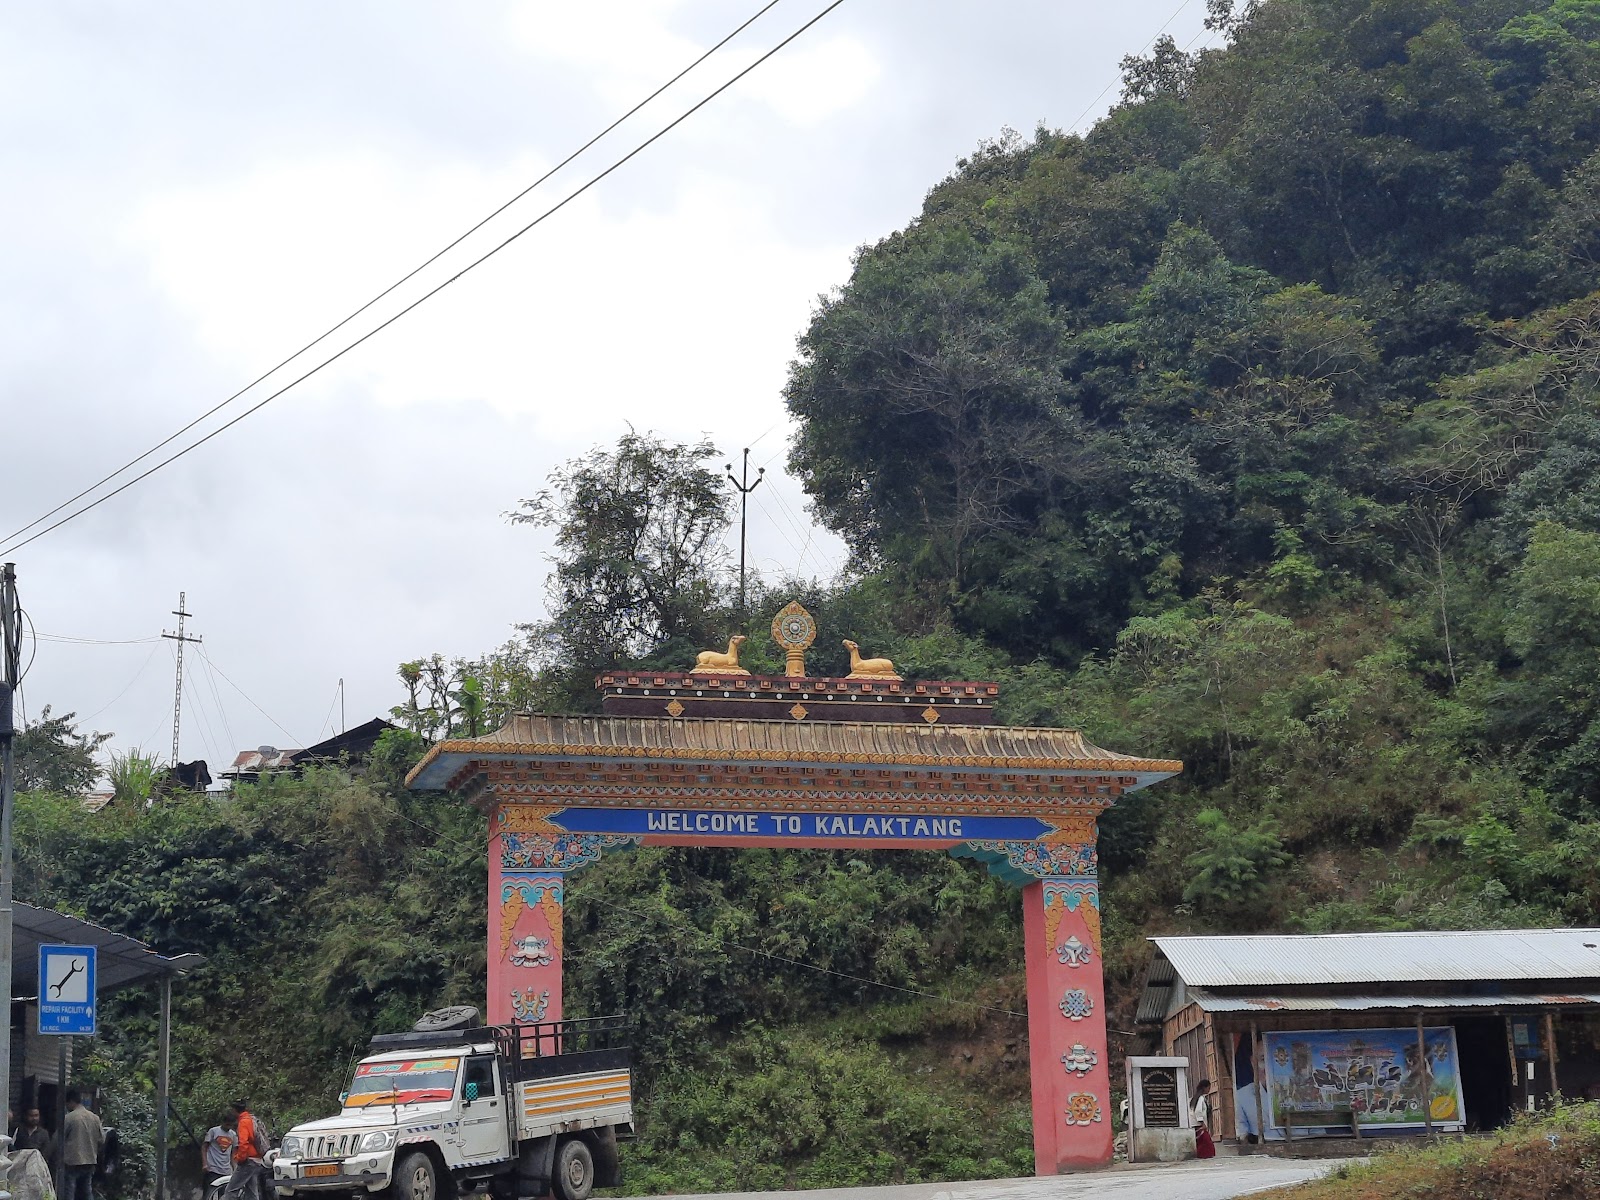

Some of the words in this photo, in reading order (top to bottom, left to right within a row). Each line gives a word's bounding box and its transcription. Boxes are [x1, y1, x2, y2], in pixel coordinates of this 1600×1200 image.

[647, 812, 759, 833] WELCOME
[771, 815, 801, 834] TO
[815, 815, 963, 837] KALAKTANG
